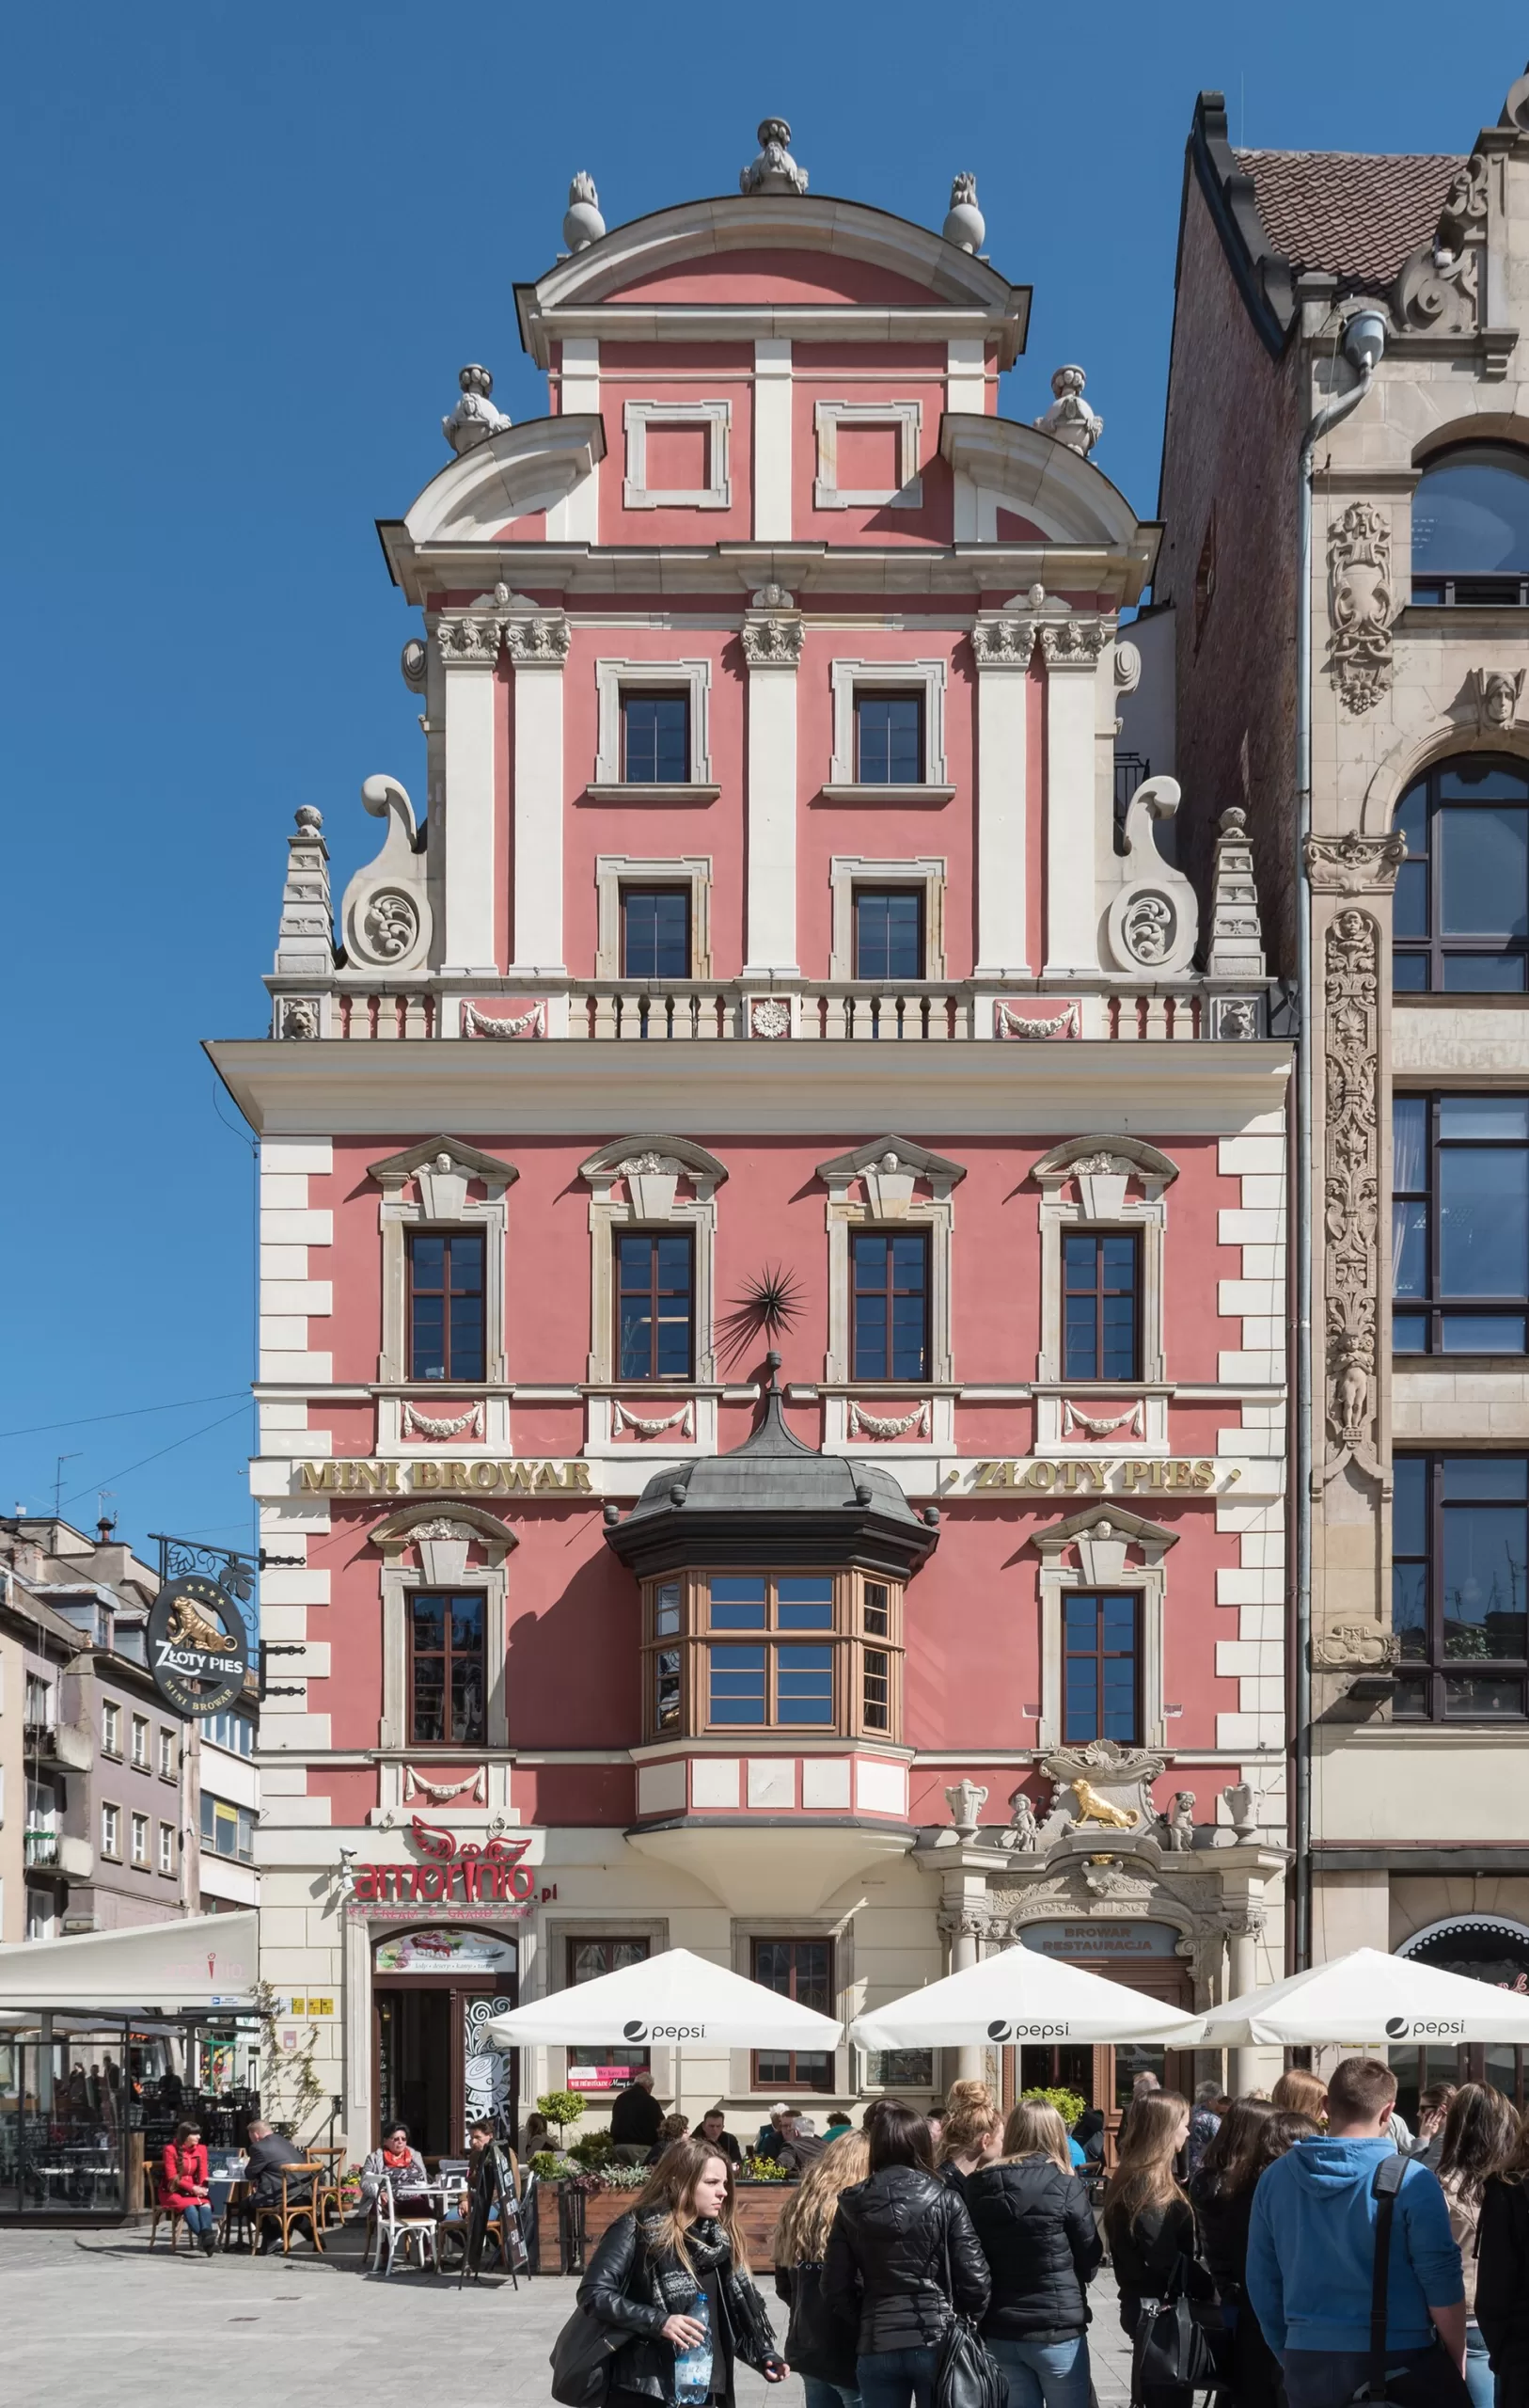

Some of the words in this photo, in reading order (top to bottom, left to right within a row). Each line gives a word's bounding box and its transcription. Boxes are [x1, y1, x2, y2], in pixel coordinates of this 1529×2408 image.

[300, 1461, 400, 1490] MINI
[412, 1461, 593, 1490] BROWAR
[975, 1461, 1114, 1489] ZŁOTY
[1122, 1460, 1216, 1488] PIES
[155, 1640, 207, 1675] ZŁOTY
[209, 1657, 244, 1674] PIES
[165, 1679, 188, 1705] MINI
[192, 1688, 233, 1711] BROWAR
[1064, 1927, 1132, 1938] BROWAR
[1042, 1941, 1153, 1952] RESTAURACJA
[652, 2024, 706, 2041] pepsi
[1017, 2021, 1070, 2039] pepsi
[1412, 2020, 1465, 2036] pepsi
